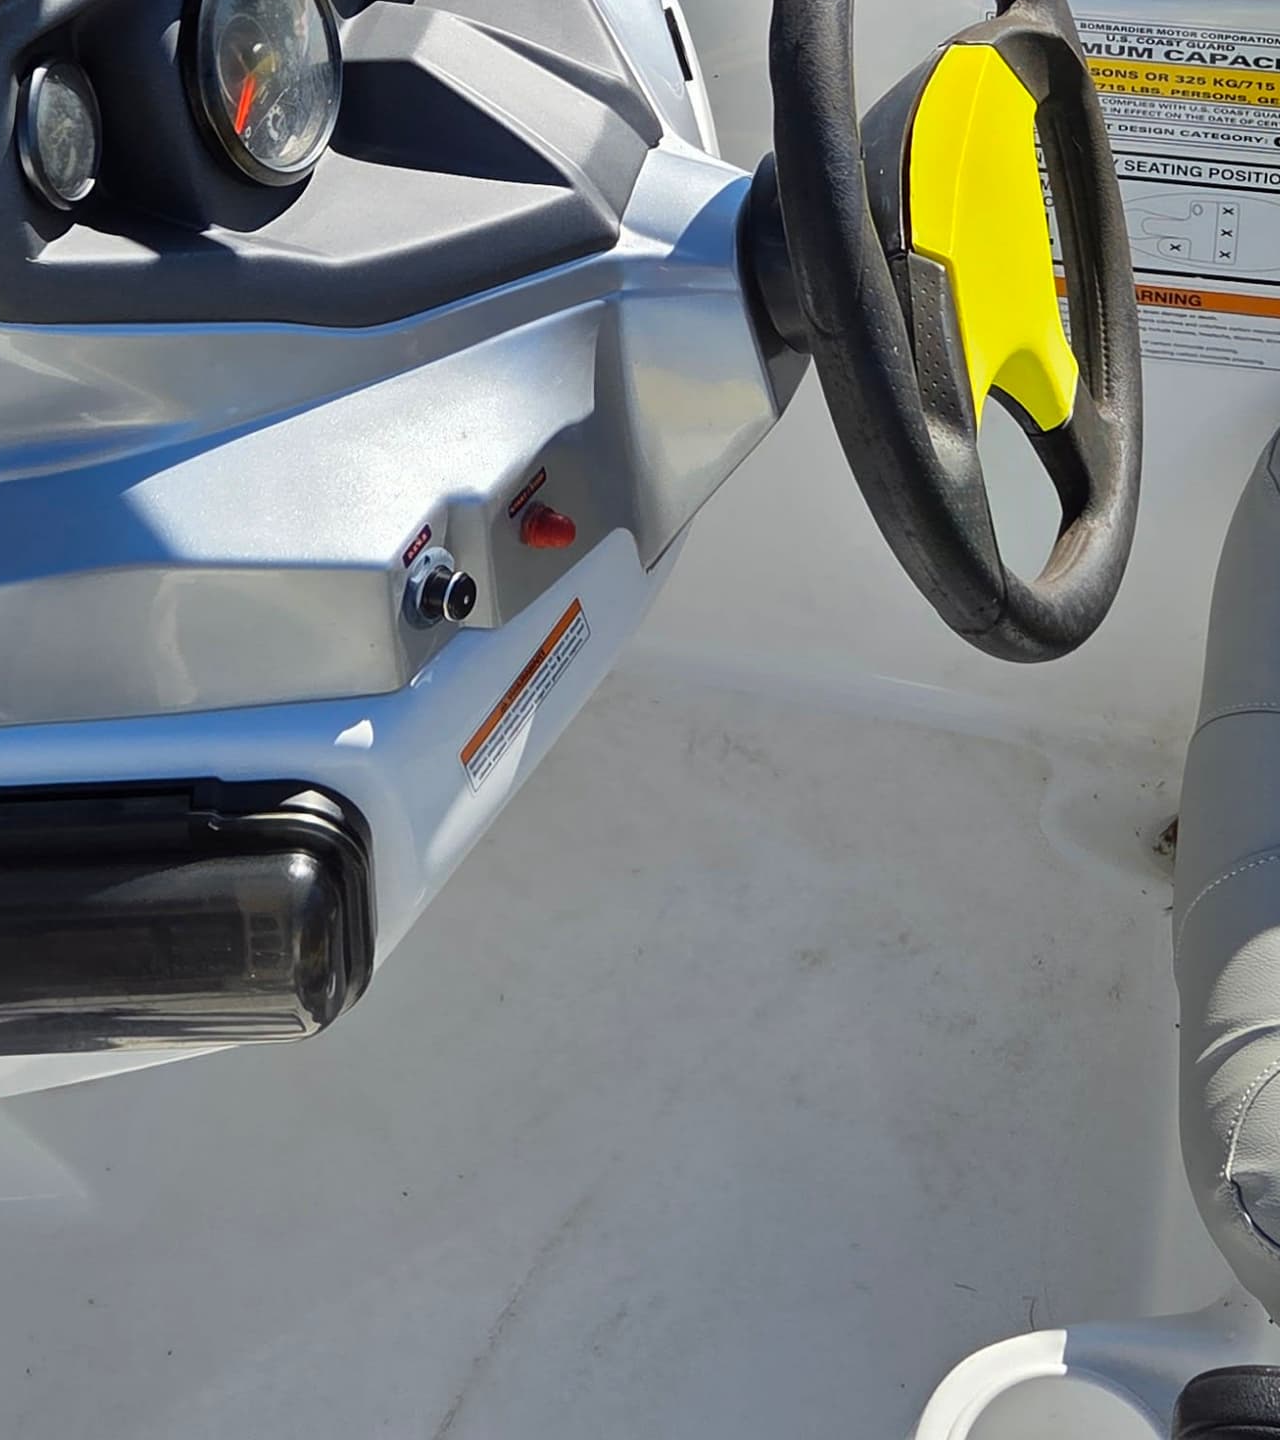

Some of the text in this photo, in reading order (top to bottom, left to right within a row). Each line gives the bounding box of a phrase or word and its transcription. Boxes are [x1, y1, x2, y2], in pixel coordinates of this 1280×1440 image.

[1080, 22, 1153, 35] BOMBARDIER
[1156, 28, 1198, 39] MOTOR
[1106, 35, 1236, 52] U.S. COAST GUARD
[1090, 67, 1139, 80] SONS
[1145, 72, 1169, 82] OR
[1175, 75, 1207, 86] 325
[1213, 77, 1275, 91] KG/715
[1171, 88, 1251, 105] PERSONS,
[1102, 98, 1156, 109] COMPLIES
[1158, 102, 1186, 111] WITH
[1213, 108, 1250, 117] COAST
[1124, 108, 1162, 118] EFFECT
[1165, 112, 1182, 120] ON
[1185, 113, 1205, 121] THE
[1208, 115, 1236, 124] DATE
[1239, 118, 1254, 126] OF
[1118, 124, 1175, 136] DESIGN
[1124, 159, 1202, 178] SEATING
[1135, 289, 1202, 307] RNING
